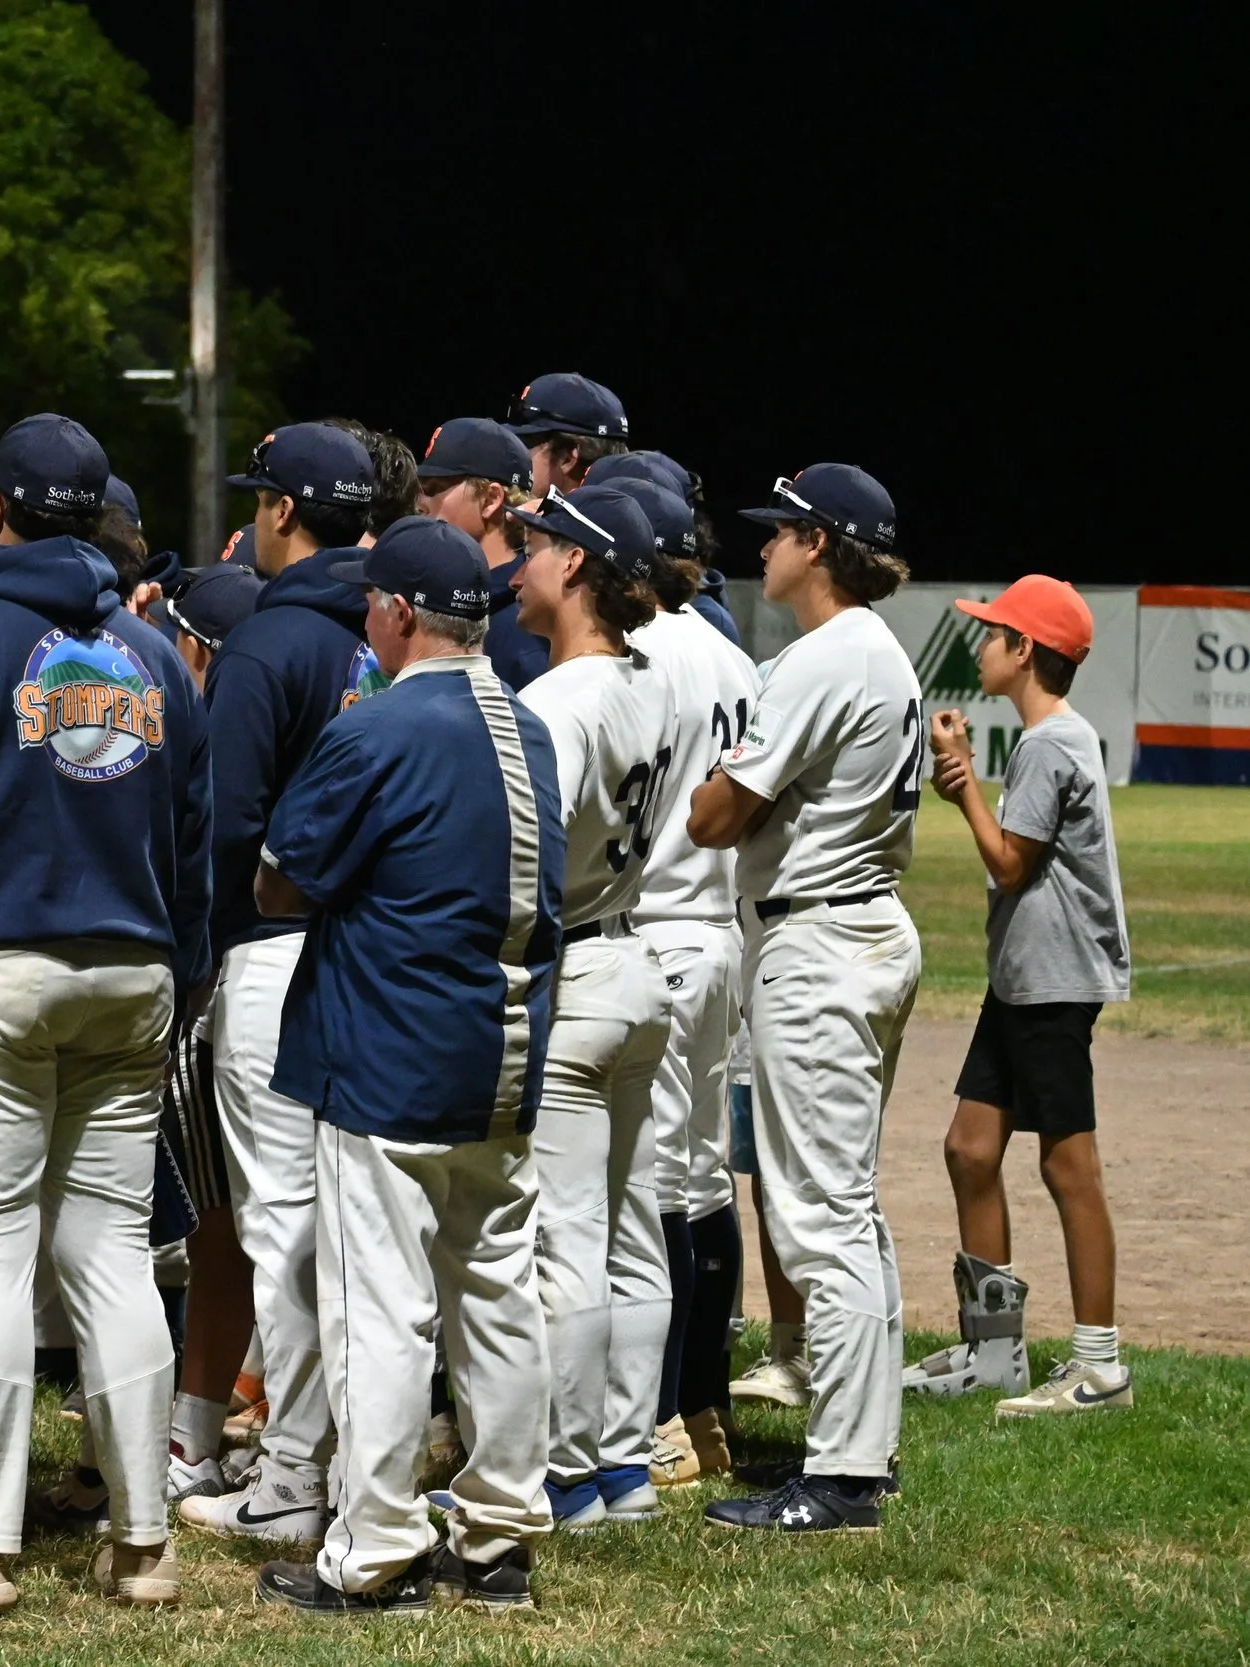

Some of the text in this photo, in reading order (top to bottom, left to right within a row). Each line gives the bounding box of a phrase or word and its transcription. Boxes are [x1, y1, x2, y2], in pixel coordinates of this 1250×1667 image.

[13, 678, 165, 751] STOMPERS
[1192, 690, 1250, 709] INTER
[55, 756, 134, 779] BASEBALL CLUB
[606, 746, 672, 874] 30
